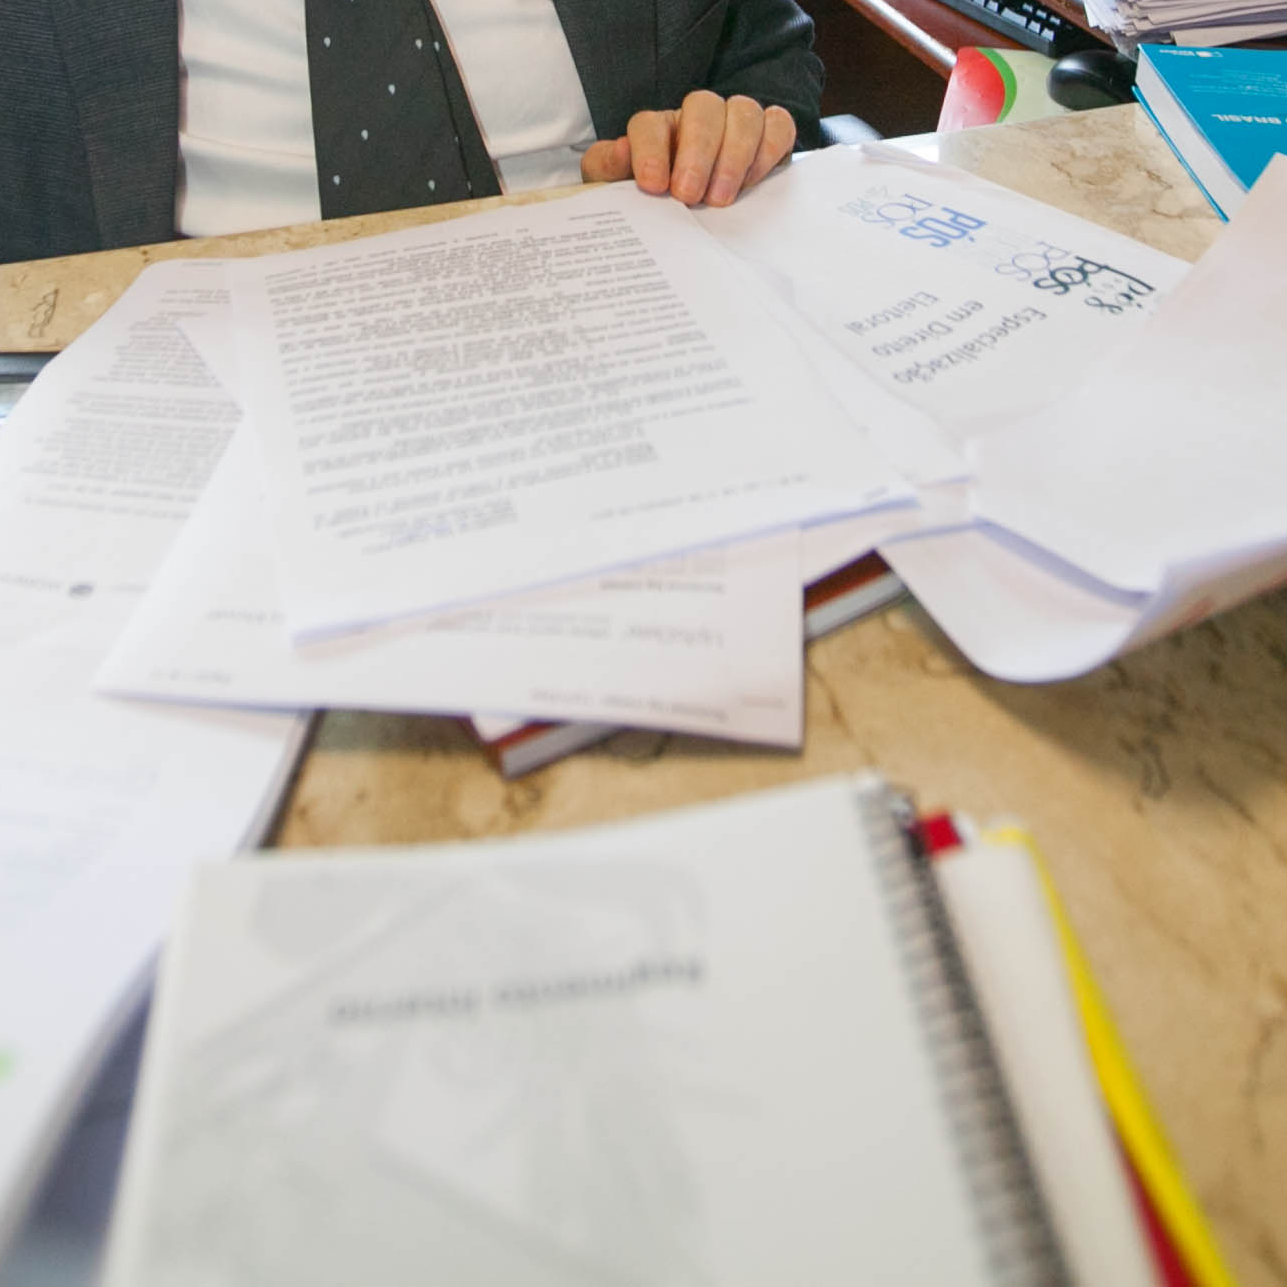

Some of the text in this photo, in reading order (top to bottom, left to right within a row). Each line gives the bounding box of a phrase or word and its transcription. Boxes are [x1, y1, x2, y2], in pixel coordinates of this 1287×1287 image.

[1211, 114, 1281, 125] BRASIL
[899, 207, 988, 248] PÓS
[843, 291, 939, 337] Eleitoral
[871, 300, 984, 358] em Direito
[892, 306, 1047, 385] Especialização
